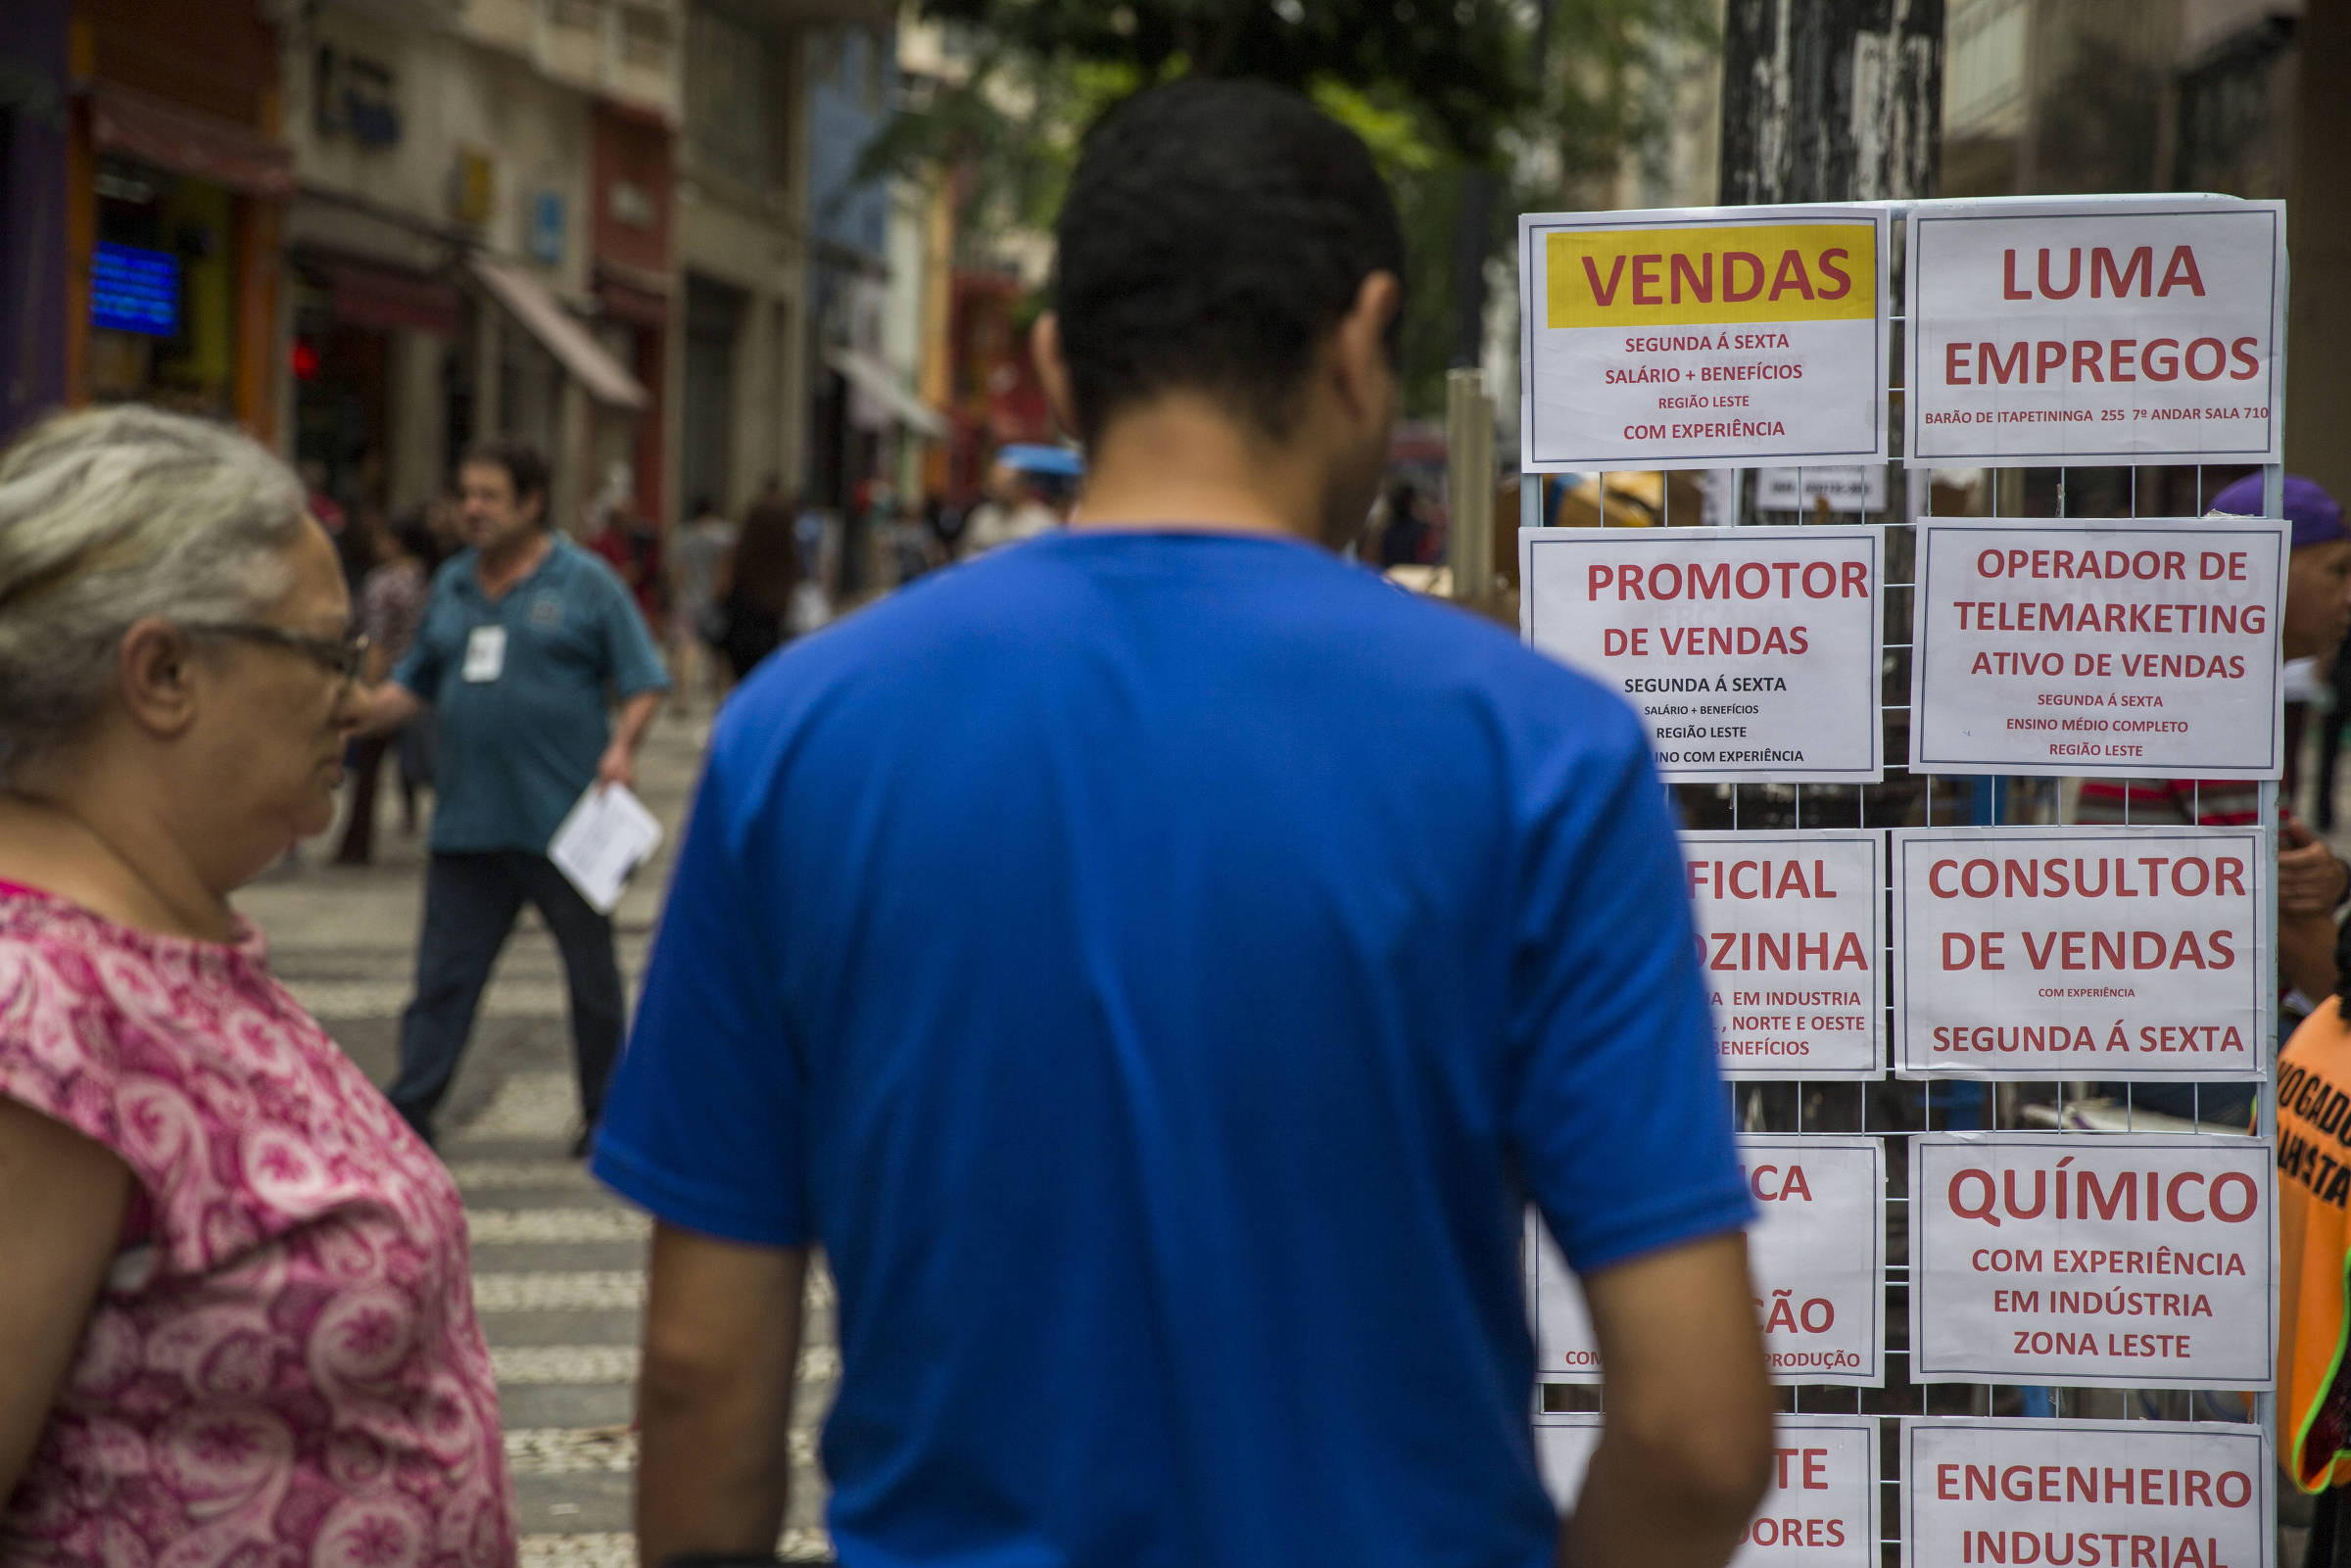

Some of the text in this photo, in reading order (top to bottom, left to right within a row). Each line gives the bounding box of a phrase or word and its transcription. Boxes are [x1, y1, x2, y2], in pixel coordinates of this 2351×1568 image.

[1581, 248, 1851, 307] VENDAS
[2003, 245, 2205, 300] LUMA
[1625, 332, 1789, 353] SEGUNDA Á SEXTA
[1606, 361, 1802, 384] SALÁRIO + BENEFÍCIOS
[1945, 337, 2259, 385] EMPREGOS
[1658, 395, 1750, 409] REGIÃO LESTE
[1925, 409, 1971, 424] BARÃO
[1976, 412, 1992, 423] DE
[1997, 410, 2092, 423] ITAPETININGA
[2101, 409, 2125, 421] 255
[2151, 408, 2200, 421] ANDAR
[2205, 407, 2239, 420] SALA
[2244, 407, 2268, 419] 710
[1623, 419, 1785, 440] COM EXPERIÊNCIA
[1977, 548, 2248, 581] OPERADOR DE
[1588, 561, 1868, 601] PROMOTOR
[1953, 601, 2266, 635] TELEMARKETING
[1605, 626, 1808, 656] DE VENDAS
[1971, 651, 2245, 679] ATIVO DE VENDAS
[1624, 675, 1787, 693] SEGUNDA Á SEXTA
[1645, 704, 1689, 715] SALÁRIO
[1701, 703, 1758, 714] BENEFÍCIOS
[2038, 692, 2163, 707] SEGUNDA Á SEXTA
[1656, 725, 1747, 738] REGIÃO LESTE
[2007, 717, 2188, 733] ENSINO MÉDIO COMPLETO
[1683, 751, 1715, 763] COM
[1719, 748, 1803, 762] EXPERIÊNCIA
[2049, 741, 2143, 757] REGIÃO LESTE
[1929, 857, 2246, 899] CONSULTOR
[1942, 929, 2234, 971] DE VENDAS
[1734, 992, 1759, 1005] EM
[1766, 992, 1860, 1005] INDUSTRIA
[2039, 986, 2135, 998] COM EXPERIÊNCIA
[1733, 1017, 1791, 1030] NORTE
[1798, 1017, 1805, 1030] E
[1811, 1017, 1864, 1030] OESTE
[1933, 1020, 2244, 1052] SEGUNDA Á SEXTA
[1948, 1156, 2258, 1227] QUÍMICO
[1972, 1246, 2245, 1276] COM EXPERIÊNCIA
[1994, 1286, 2212, 1317] EM INDÚSTRIA
[2014, 1332, 2190, 1357] ZONA LESTE
[1937, 1463, 2251, 1508] ENGENHEIRO
[1963, 1530, 2229, 1568] INDUSTRIAL
